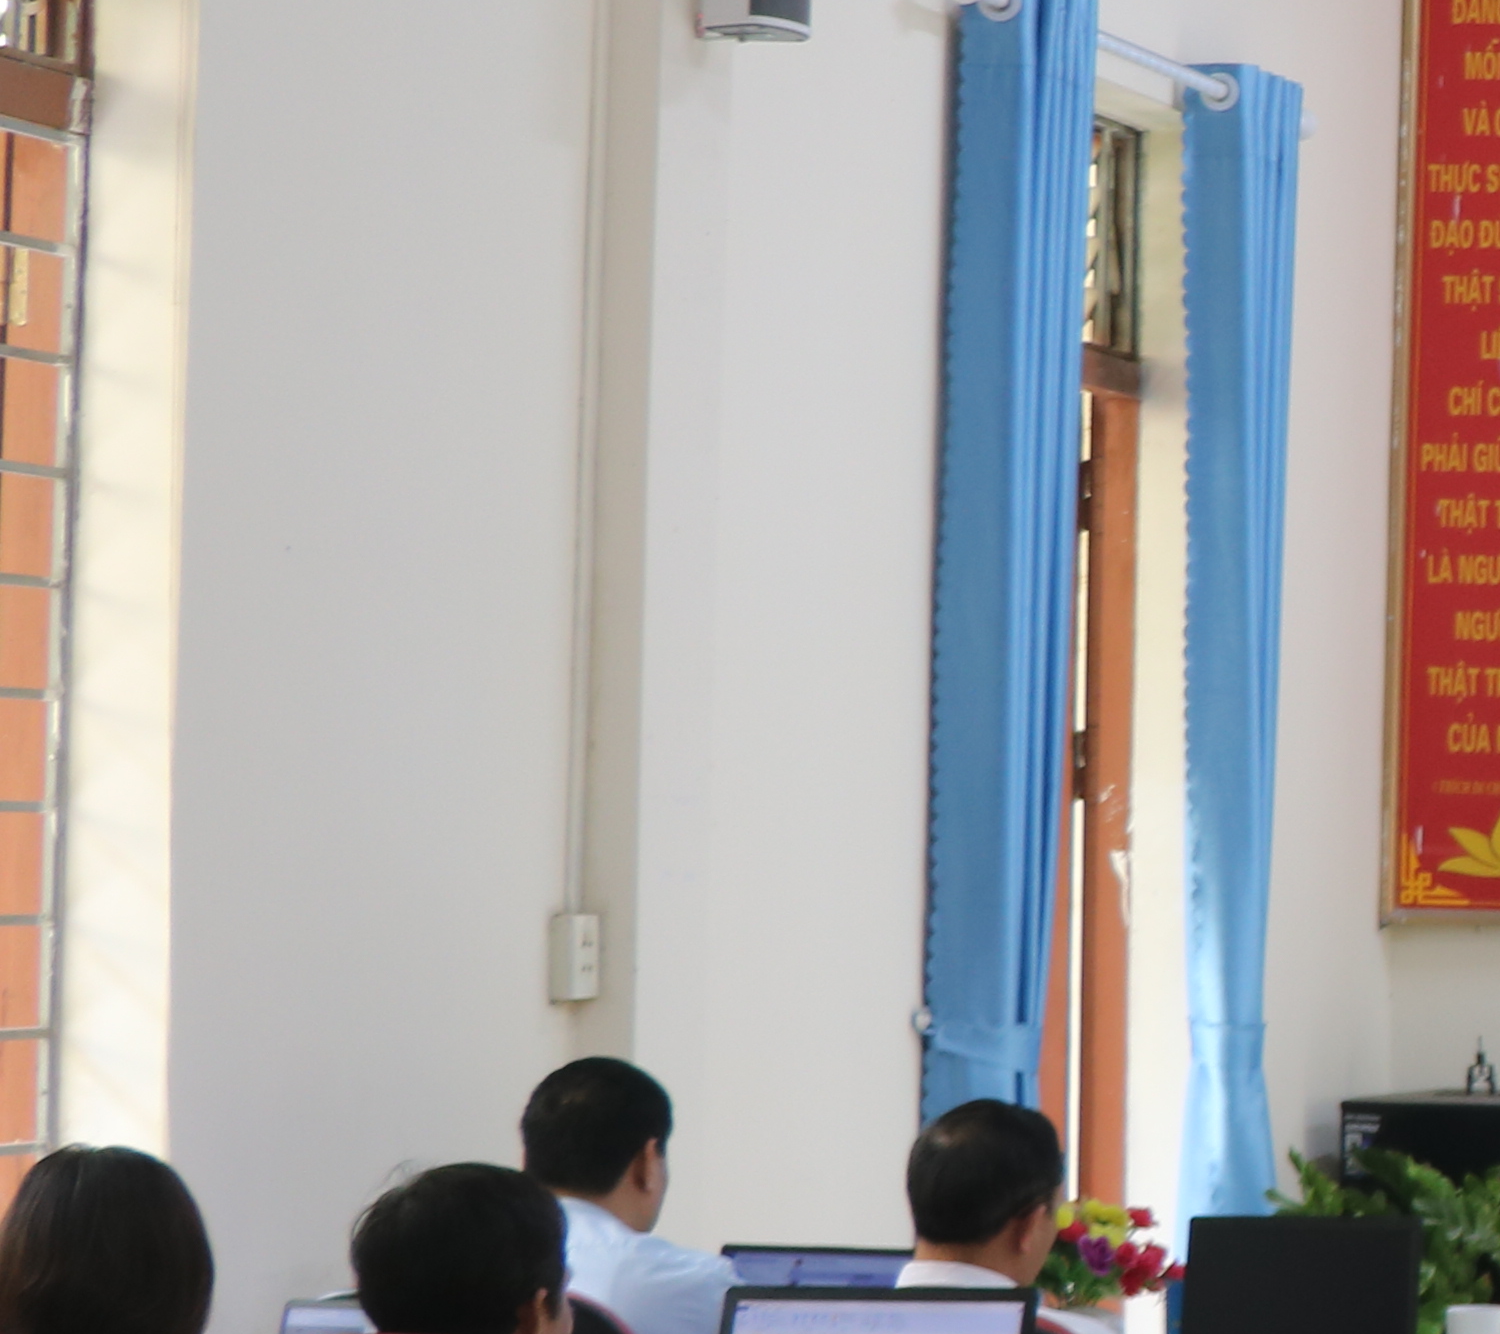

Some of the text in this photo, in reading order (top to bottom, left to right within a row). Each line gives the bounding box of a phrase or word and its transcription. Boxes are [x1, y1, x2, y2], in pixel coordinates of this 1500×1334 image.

[1462, 100, 1491, 136] VÀ
[1429, 211, 1475, 257] ĐẠO
[1441, 268, 1496, 312] THẬT
[1448, 380, 1483, 416] CHÍ
[1420, 431, 1469, 472] PHẢI
[1436, 492, 1492, 534] THẬT
[1426, 547, 1454, 584] LÀ
[1426, 660, 1481, 703] THẬT
[1446, 712, 1492, 754] CỦA
